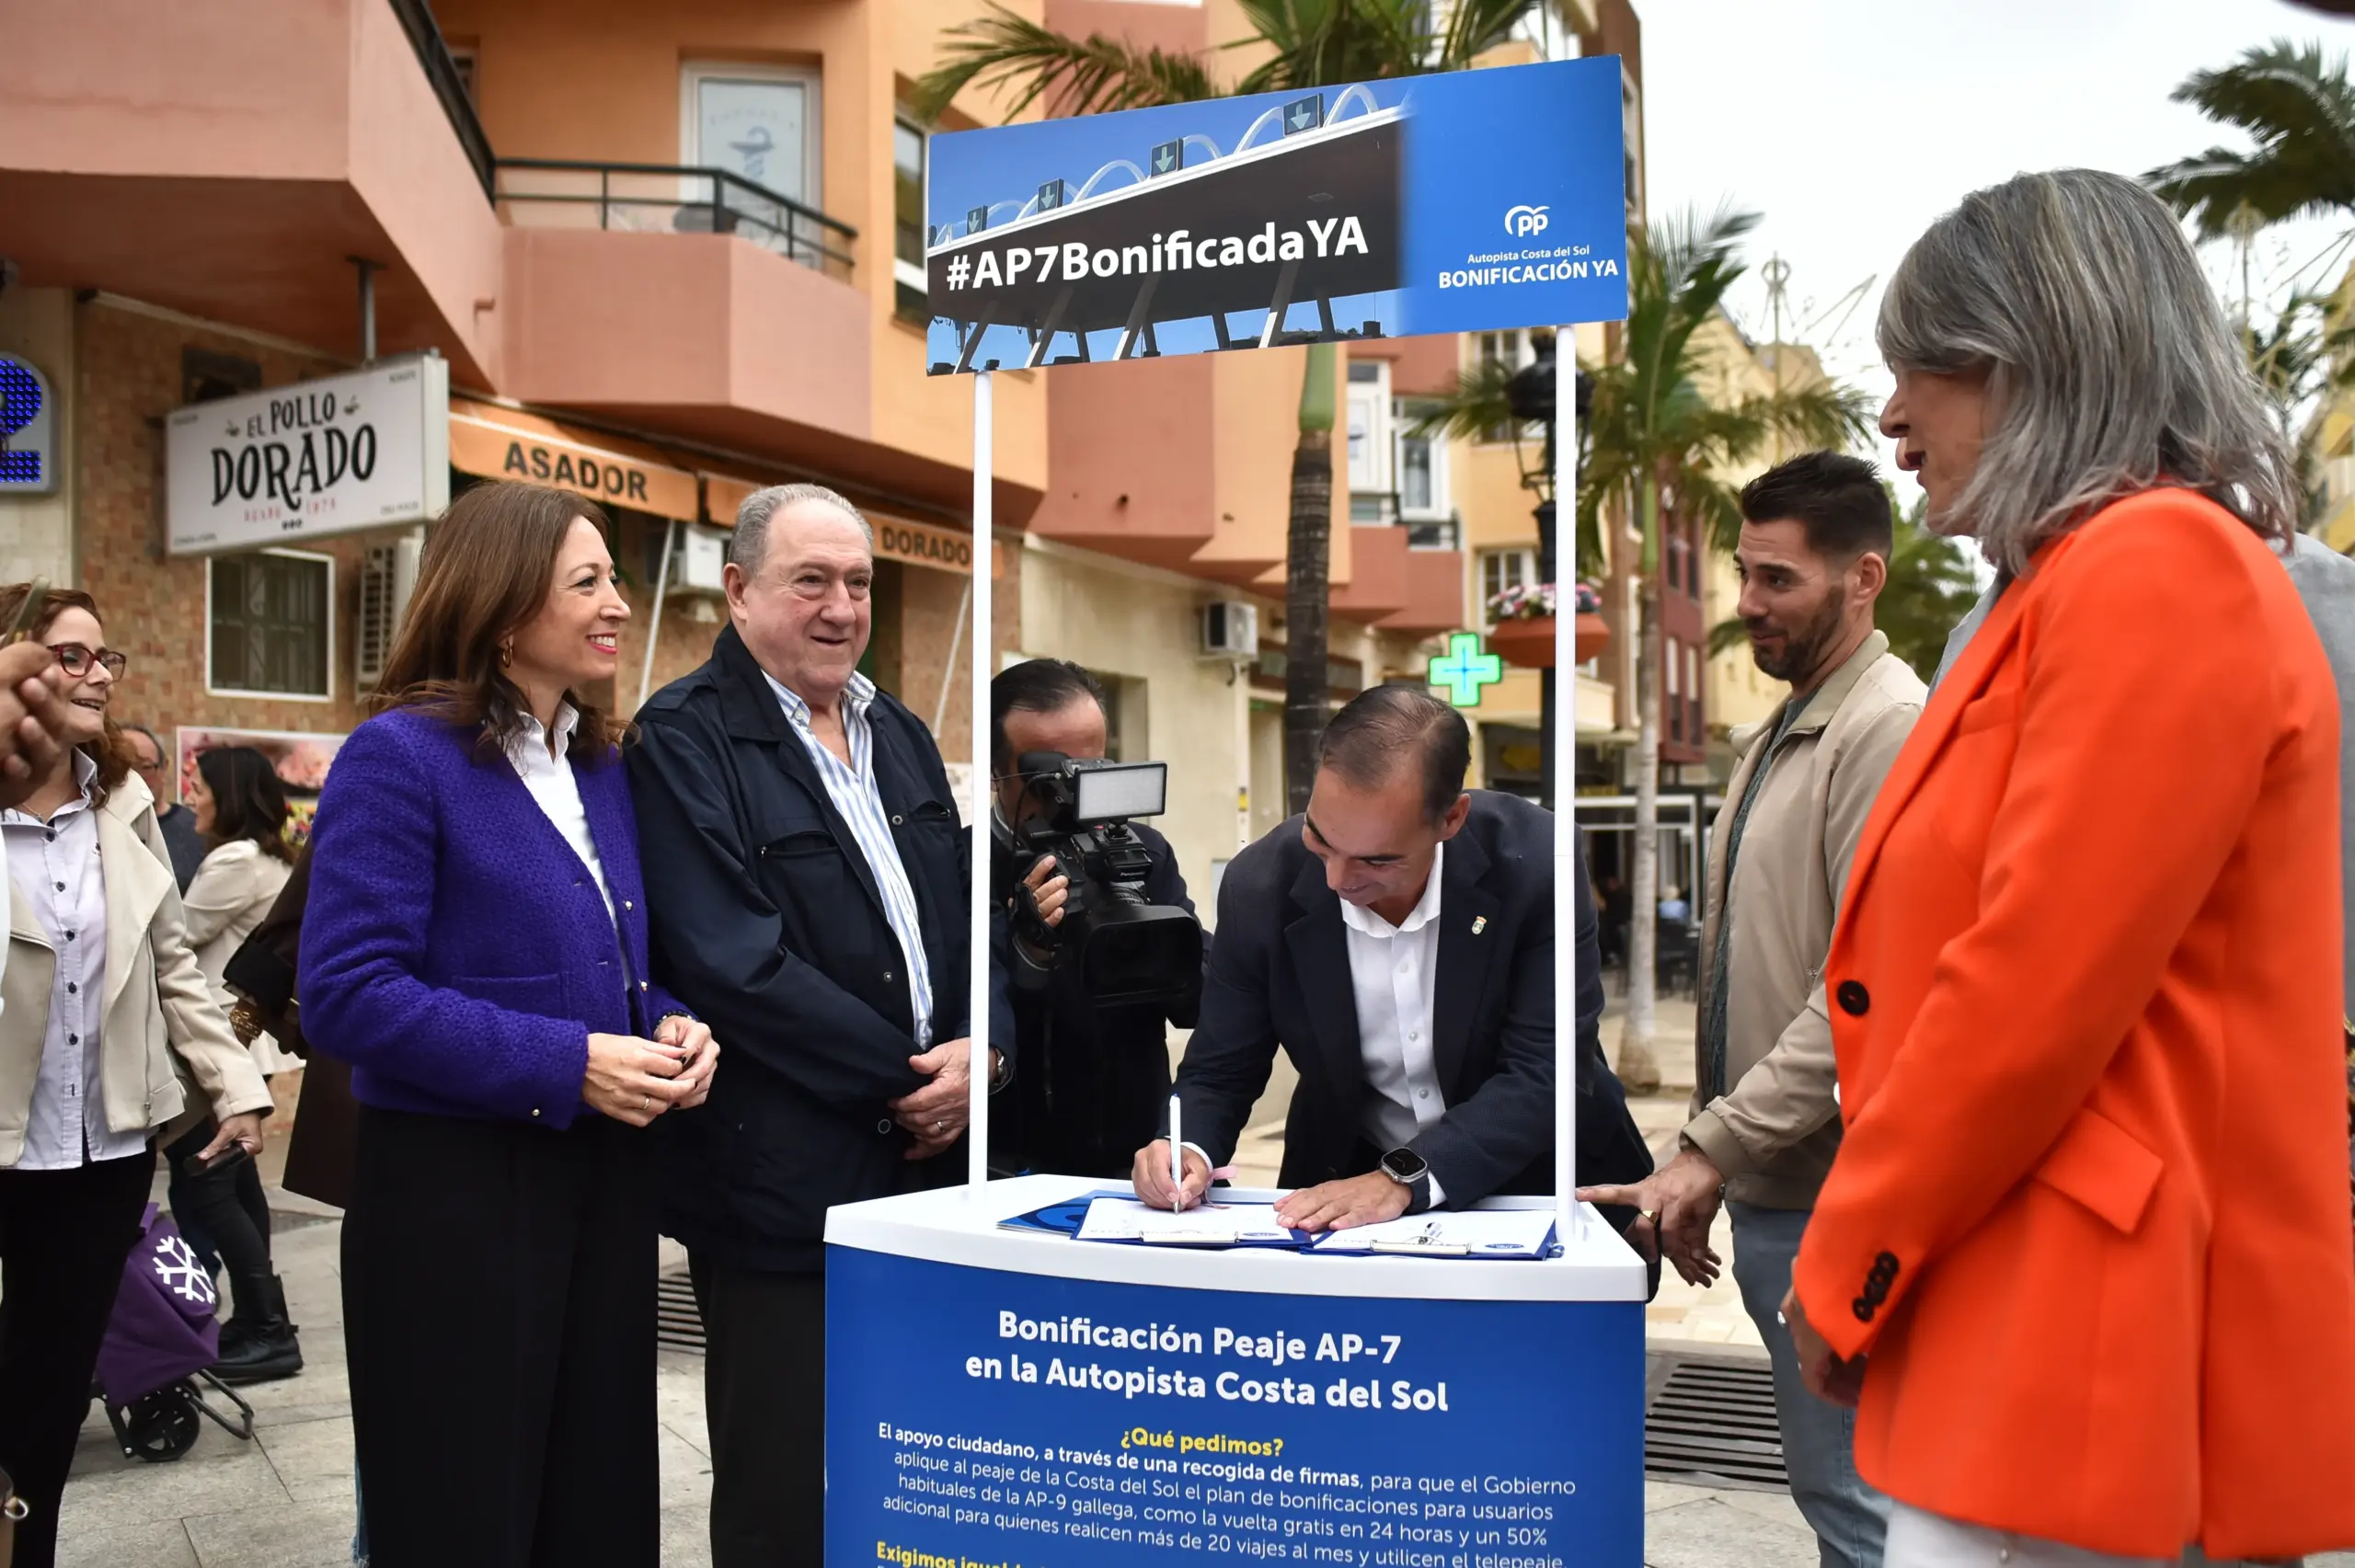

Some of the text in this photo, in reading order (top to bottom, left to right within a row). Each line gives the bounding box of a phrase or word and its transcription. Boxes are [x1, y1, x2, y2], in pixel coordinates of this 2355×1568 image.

[946, 216, 1369, 291] #AP7BonificadaYA
[1439, 259, 1619, 289] BONIFICACIÓN YA
[1467, 245, 1590, 264] Autopista Costa del Sol
[247, 392, 336, 438] EL POLLO
[211, 424, 377, 511] DORADO
[503, 441, 648, 502] ASADOR
[881, 525, 971, 567] DORADO
[1000, 1310, 1402, 1366] Bonificación Peaje AP-7
[966, 1355, 1449, 1412] en la Autopista Costa del Sol
[879, 1423, 1576, 1494] El apoyo ciudadano, a través de una recogida de firmas, para que el Gobierno
[1120, 1427, 1284, 1458] ¿Qué pedimos?
[894, 1451, 1554, 1520] aplique al peaje de la Costa del Sol el plan de bonificaciones para usuarios
[899, 1473, 1547, 1548] habituales de la AP-9 gallega, como la vuelta gratis en 24 horas y un 50%
[878, 1540, 956, 1568] Exigimos
[883, 1495, 950, 1519] adicional
[955, 1509, 990, 1525] para
[994, 1514, 1059, 1533] quienes
[1064, 1523, 1132, 1542] realicen
[1139, 1528, 1174, 1547] más
[1180, 1532, 1202, 1550] de
[1209, 1535, 1231, 1552] 20
[1237, 1538, 1287, 1559] viajes
[1293, 1543, 1308, 1560] al
[1315, 1548, 1353, 1562] mes
[1360, 1550, 1370, 1567] y
[1376, 1548, 1445, 1568] utilicen
[1452, 1551, 1468, 1568] el
